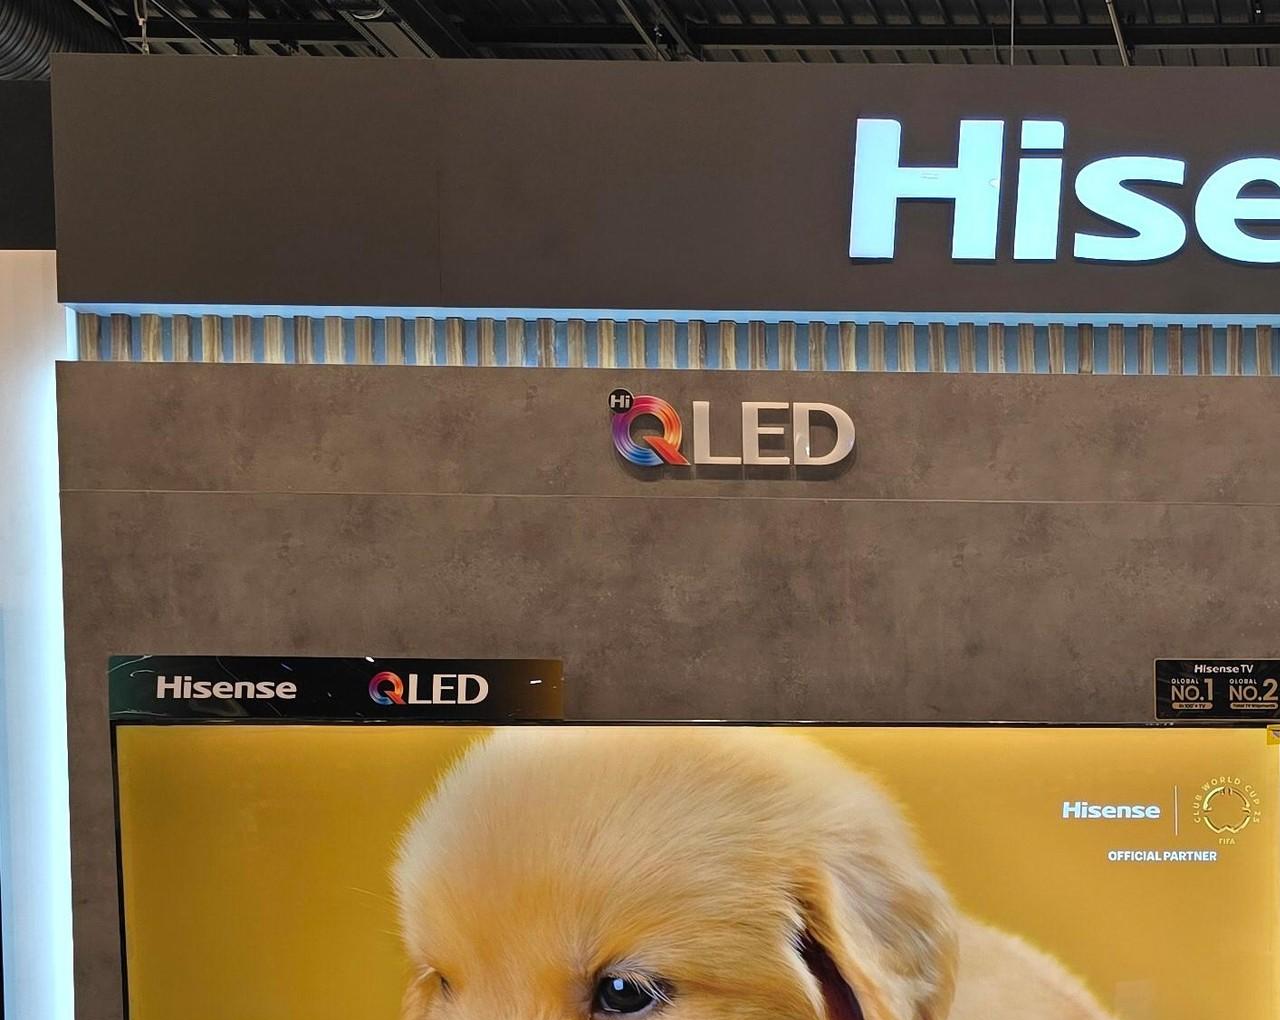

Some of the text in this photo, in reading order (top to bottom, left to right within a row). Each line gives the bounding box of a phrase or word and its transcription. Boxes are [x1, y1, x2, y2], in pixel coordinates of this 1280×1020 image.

[610, 394, 631, 409] Hi
[611, 395, 856, 467] QLED
[1194, 664, 1254, 673] Hisense TV
[156, 675, 298, 700] Hisense
[368, 671, 489, 705] QLED
[1171, 678, 1214, 701] NO.1
[1229, 678, 1279, 701] NO.2
[1062, 801, 1161, 819] Hisense
[1193, 794, 1202, 823] CLUB
[1201, 776, 1241, 791] WORLD
[1244, 785, 1260, 805] CUP
[1107, 851, 1218, 861] OFFICIAL PARTNER
